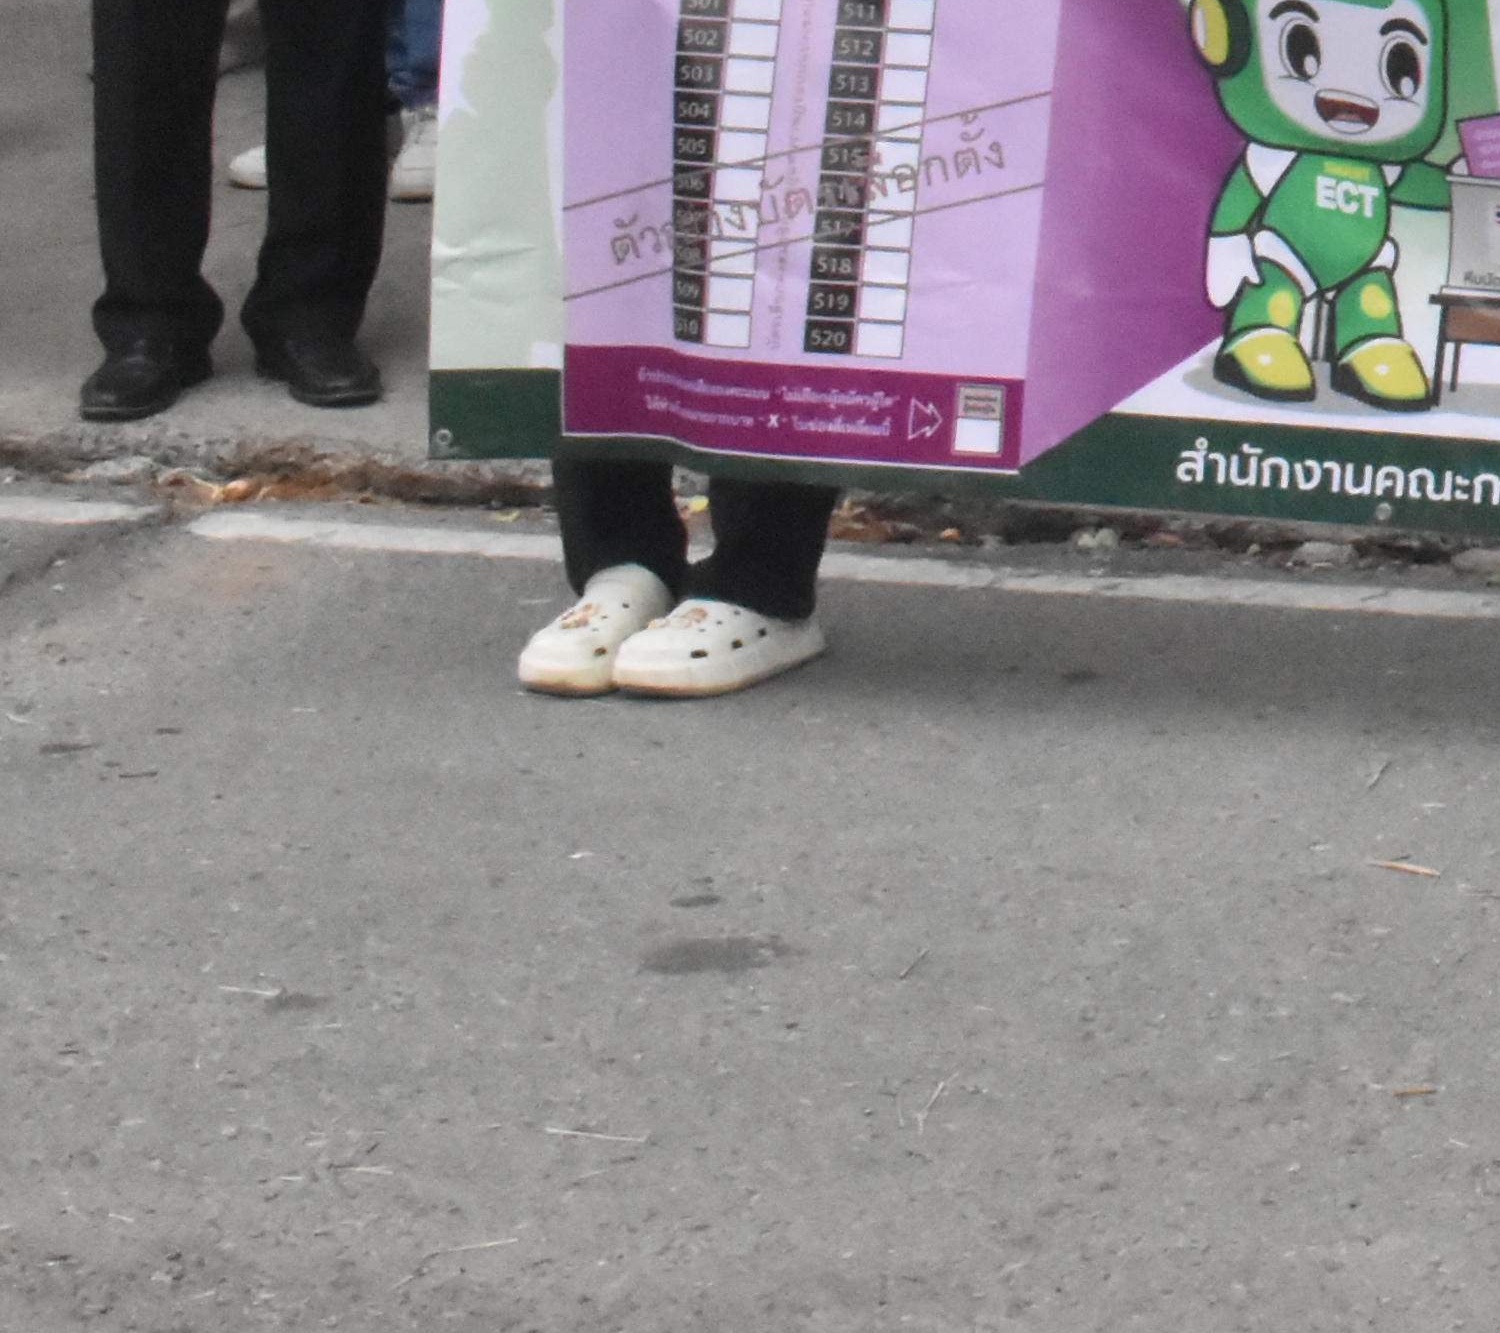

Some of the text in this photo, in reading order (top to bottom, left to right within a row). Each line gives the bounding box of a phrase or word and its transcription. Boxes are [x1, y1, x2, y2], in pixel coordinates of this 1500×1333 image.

[843, 3, 877, 21] 511
[682, 29, 719, 46] 502
[839, 39, 874, 56] 512
[679, 65, 714, 83] 503
[835, 75, 870, 92] 513
[676, 101, 711, 119] 504
[832, 112, 867, 129] 514
[676, 138, 708, 155] 505
[1314, 176, 1380, 219] ECT
[816, 256, 853, 274] 518
[813, 293, 850, 310] 519
[810, 329, 847, 347] 520
